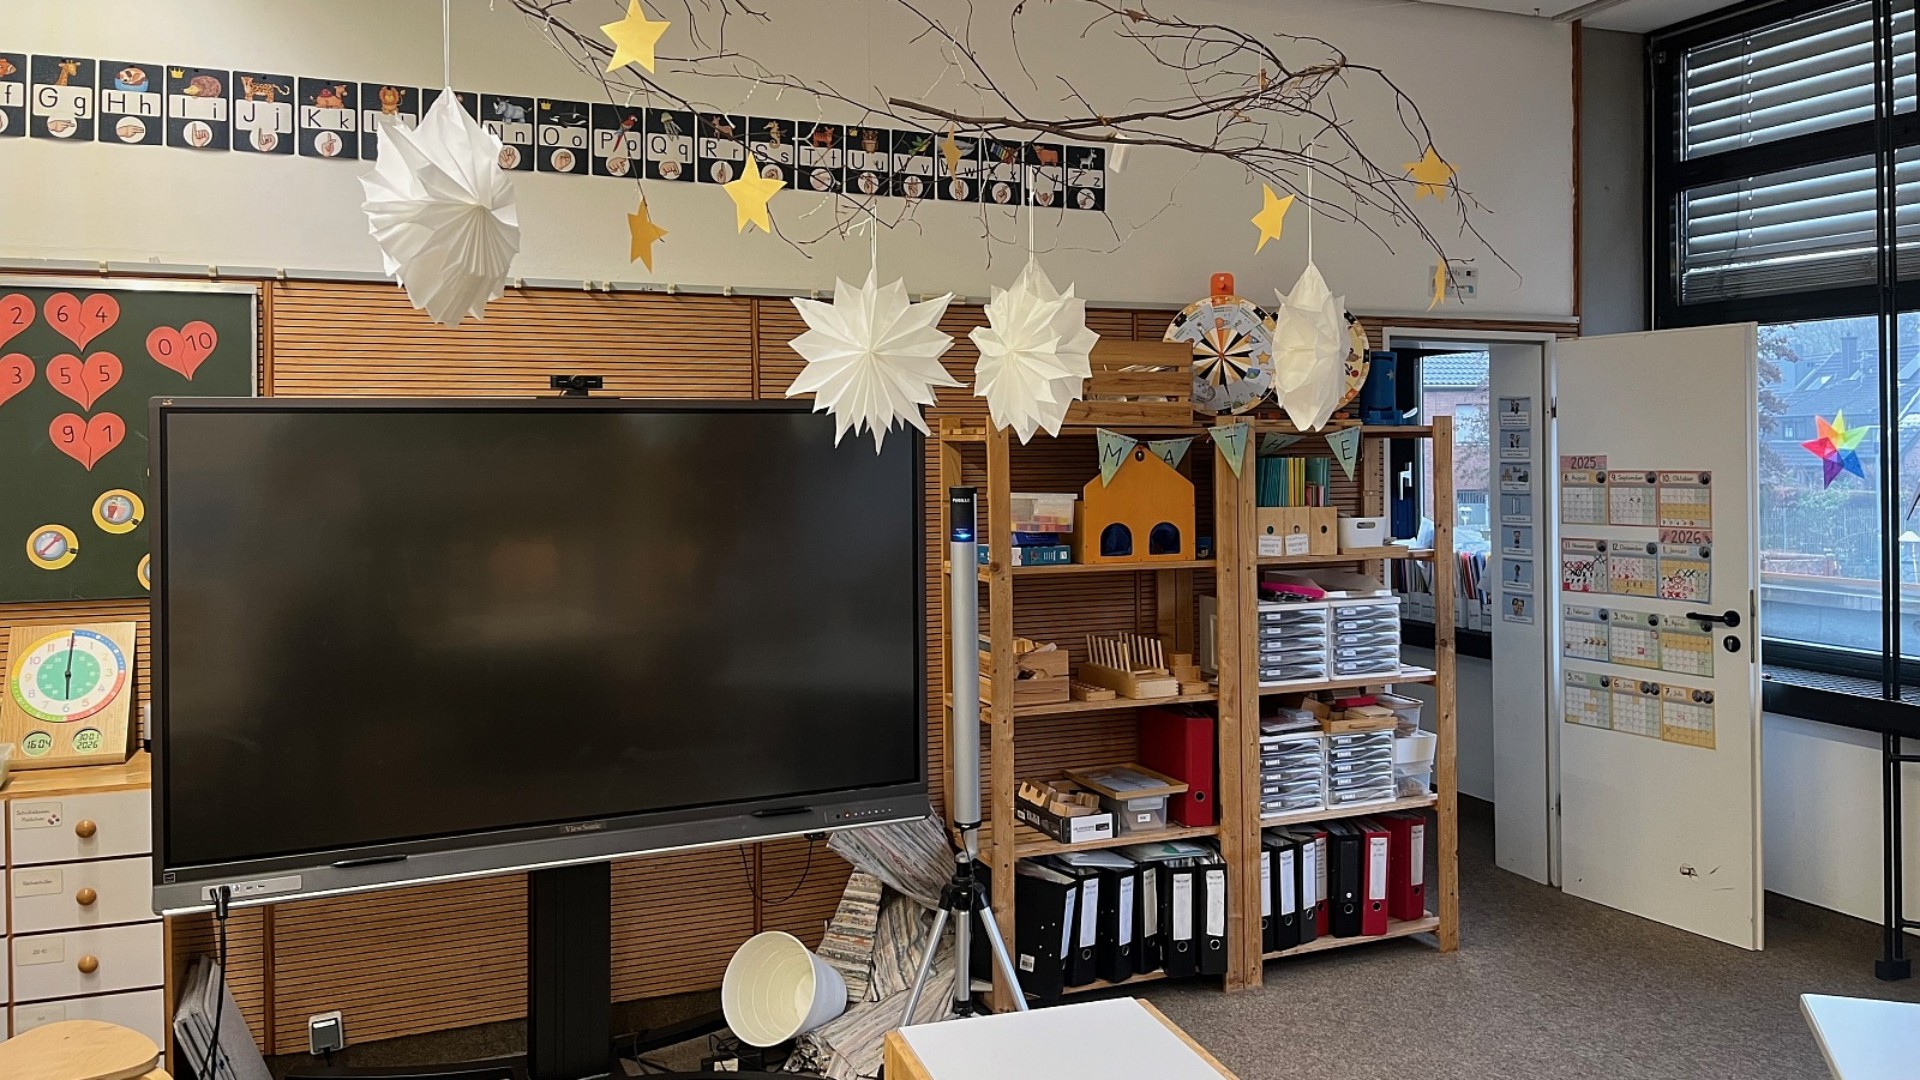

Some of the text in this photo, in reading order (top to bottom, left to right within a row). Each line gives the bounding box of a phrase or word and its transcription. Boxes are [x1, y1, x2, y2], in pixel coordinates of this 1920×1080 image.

[5, 84, 12, 104] f
[39, 87, 86, 116] G g
[107, 93, 152, 115] H h
[212, 103, 217, 119] i
[243, 103, 280, 131] J j
[307, 108, 349, 130] K k
[515, 131, 525, 143] n
[543, 127, 582, 147] O o
[601, 132, 638, 156] P p
[651, 137, 689, 162] Q q
[706, 141, 739, 159] R r
[781, 151, 789, 163] s
[807, 148, 837, 166] T t
[851, 152, 884, 171] U u
[921, 164, 930, 175] v
[1071, 171, 1101, 187] Z z
[11, 306, 24, 325] 2
[57, 305, 108, 324] 6 4
[158, 332, 213, 356] 0 10
[11, 366, 23, 384] 3
[60, 364, 110, 384] 5 5
[62, 425, 113, 443] 9 1
[1103, 443, 1123, 467] M
[1163, 449, 1175, 466] A
[1225, 434, 1237, 456] T
[1341, 439, 1353, 460] E
[1571, 457, 1597, 470] 2025
[1671, 531, 1701, 544] 2026
[29, 656, 41, 665] 10
[62, 703, 70, 713] 6
